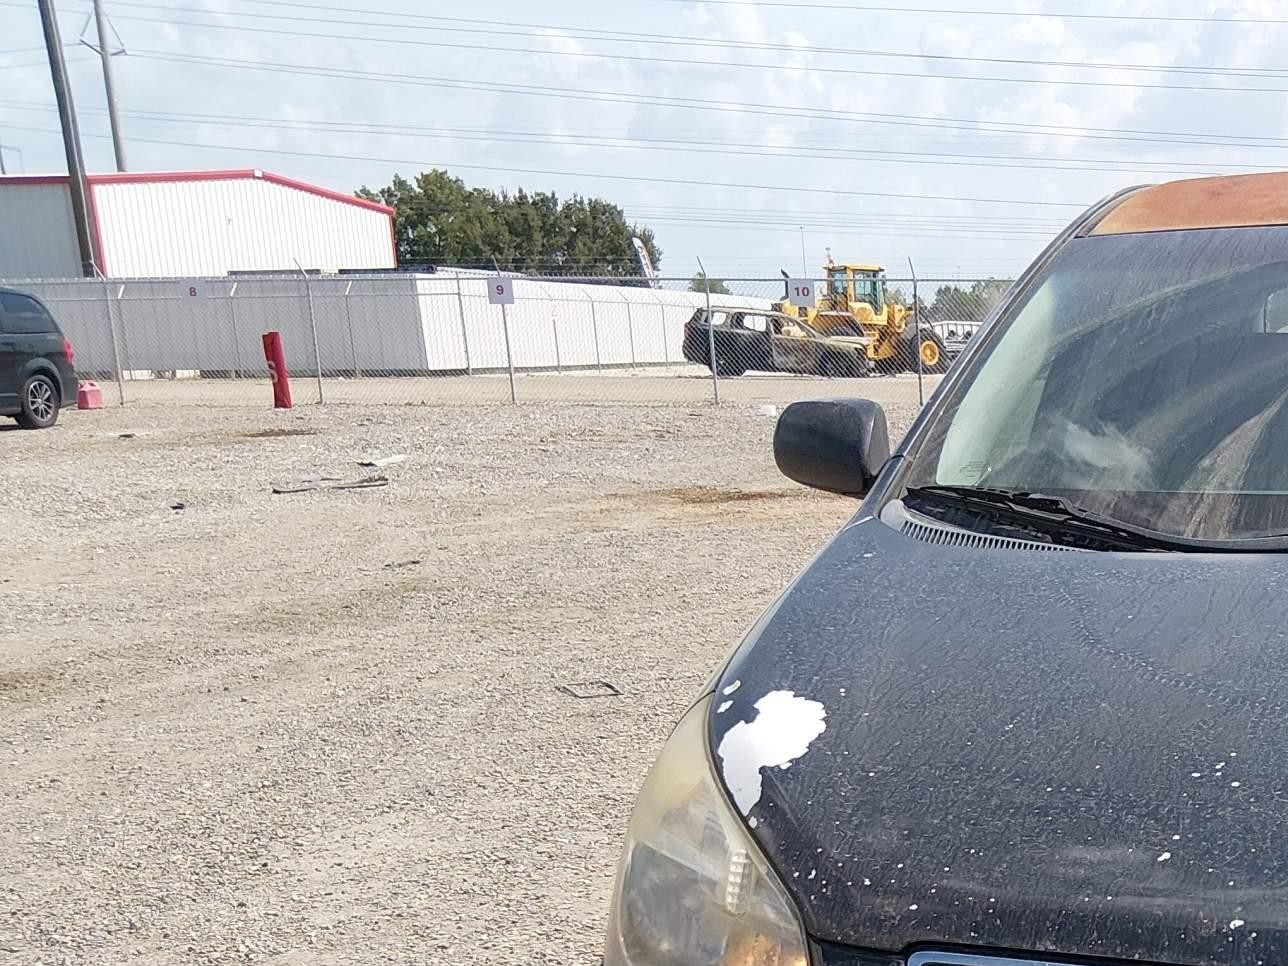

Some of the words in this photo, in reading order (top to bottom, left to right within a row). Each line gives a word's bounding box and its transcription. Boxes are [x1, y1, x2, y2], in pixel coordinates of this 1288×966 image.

[189, 286, 197, 297] 8
[495, 284, 504, 295] 9
[794, 286, 810, 297] 10
